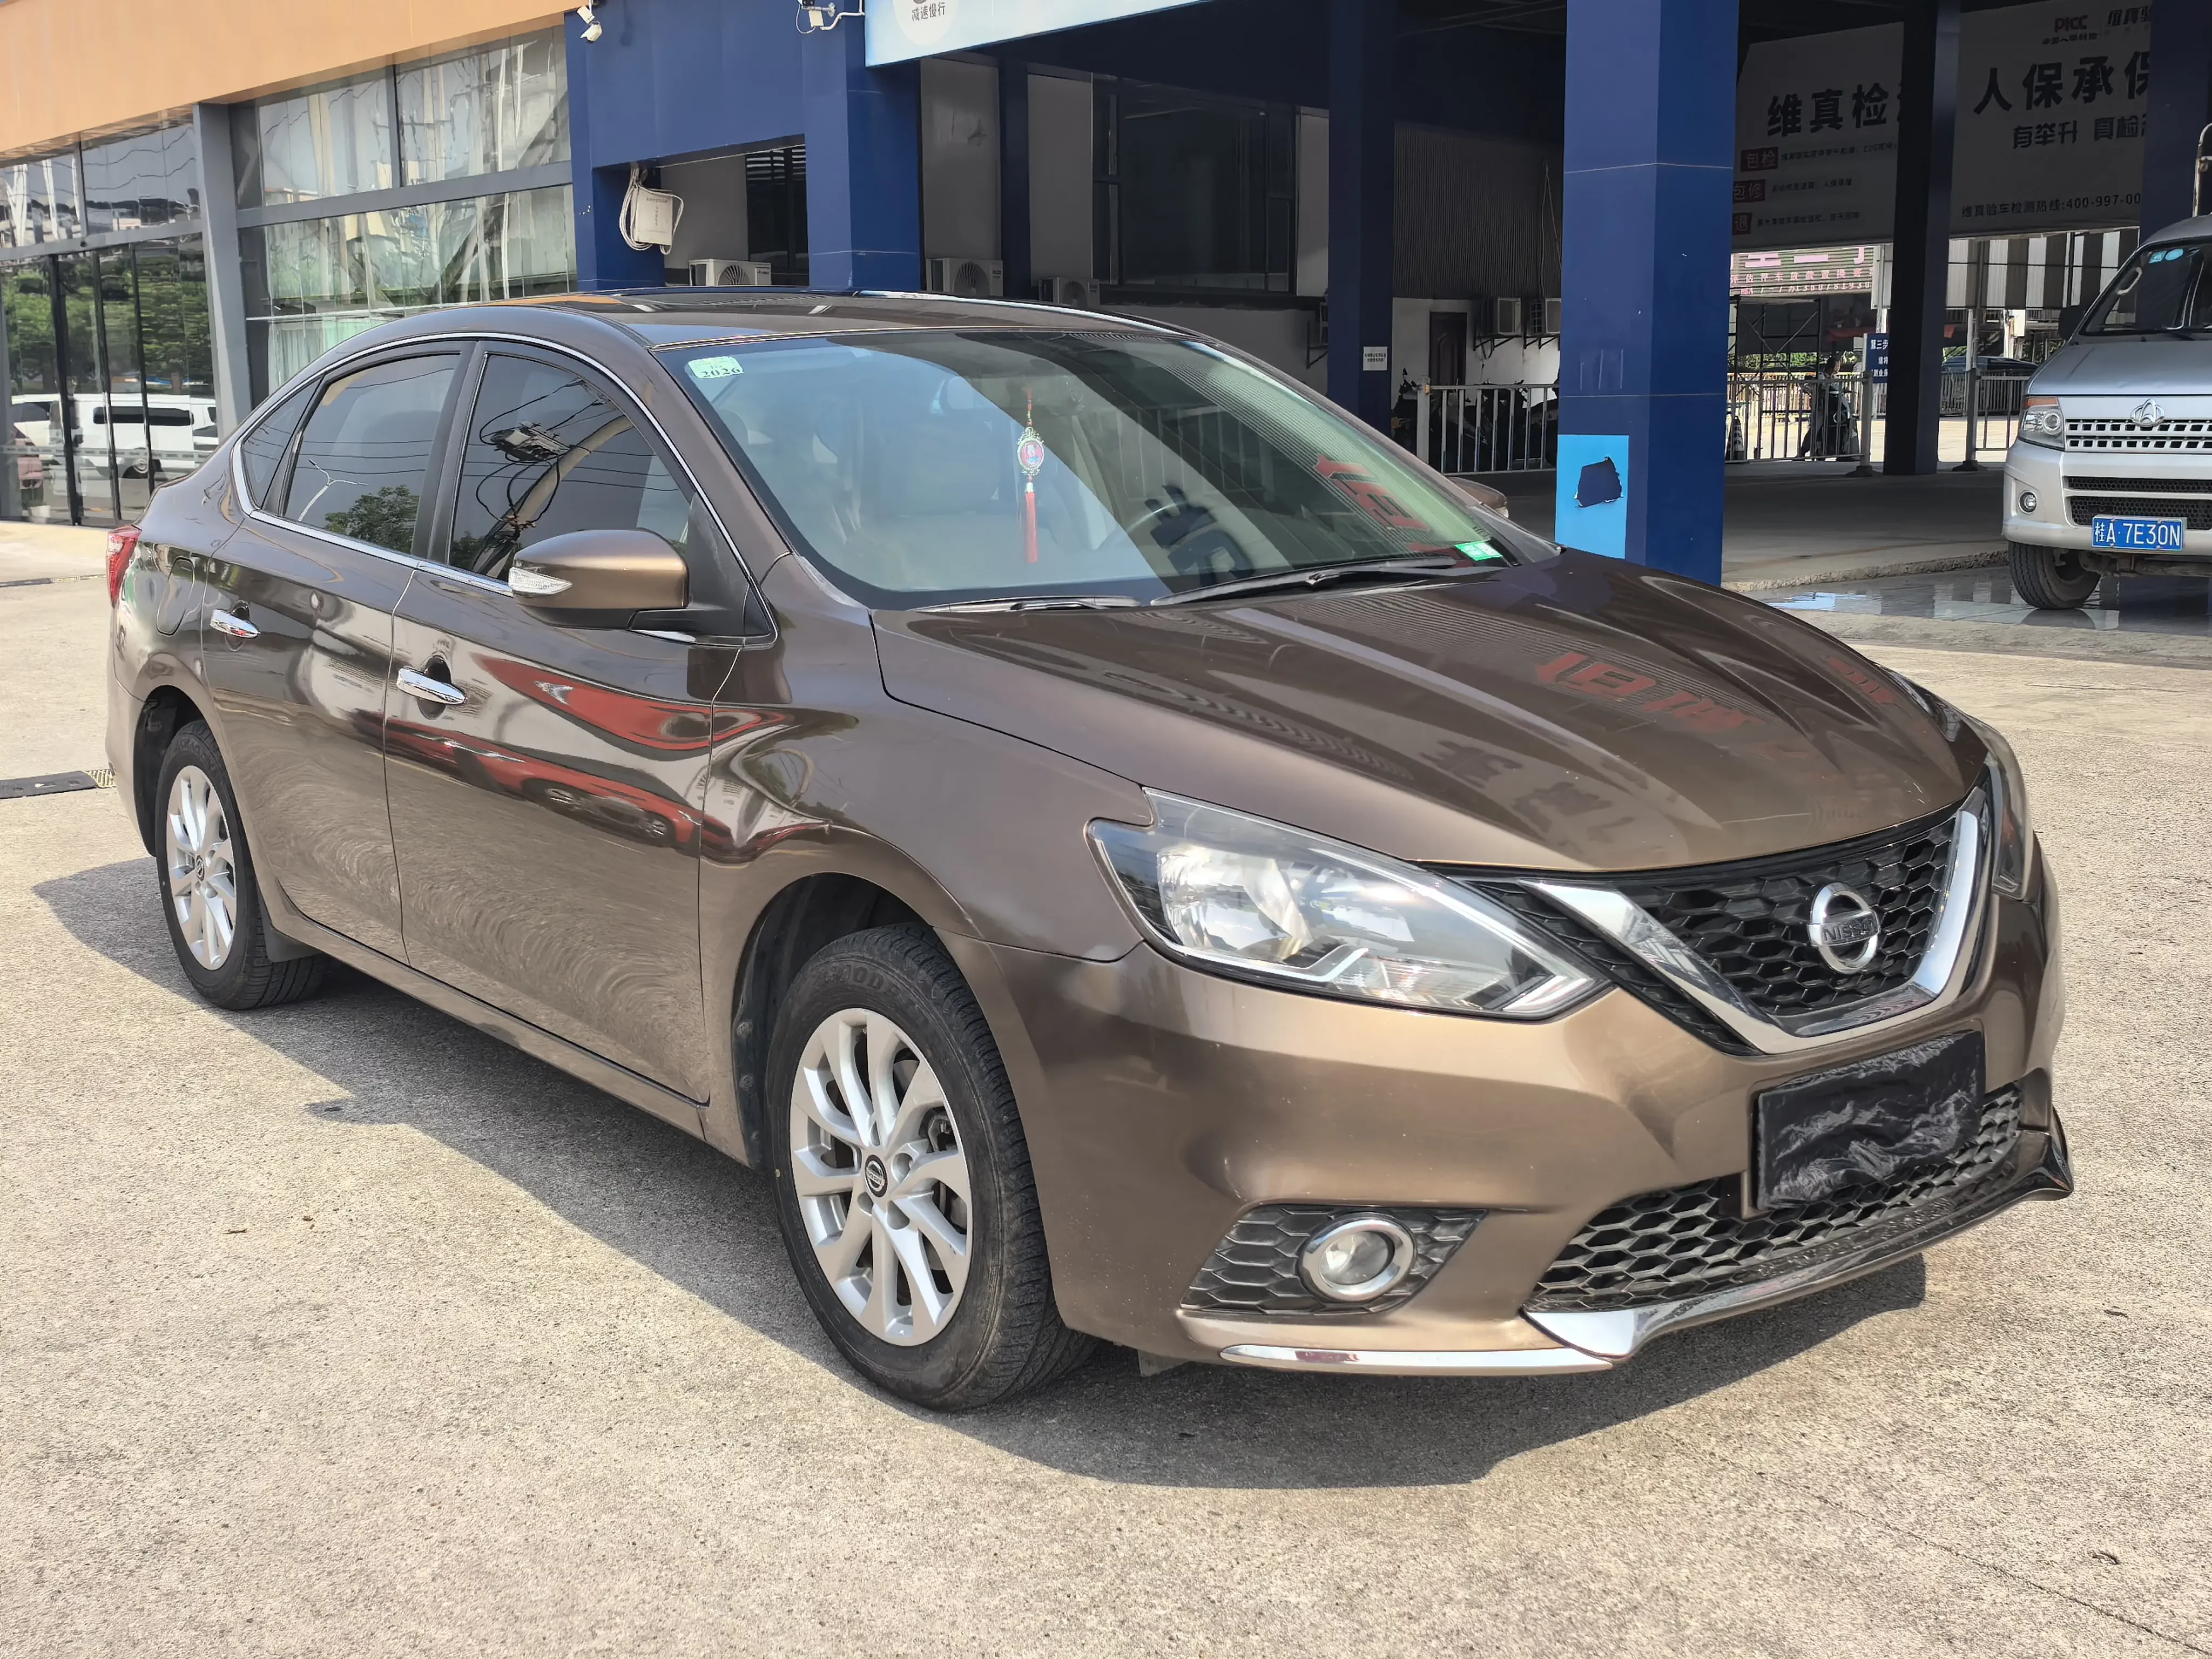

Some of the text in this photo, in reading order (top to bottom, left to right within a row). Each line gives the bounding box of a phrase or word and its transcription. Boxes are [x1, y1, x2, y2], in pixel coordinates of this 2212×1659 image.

[912, 2, 946, 22] 减速慢行
[2054, 15, 2088, 32] PICC
[1766, 82, 1901, 137] 维真检
[2013, 120, 2078, 149] 有举升
[1746, 150, 1776, 168] 包检
[701, 367, 741, 378] 2026
